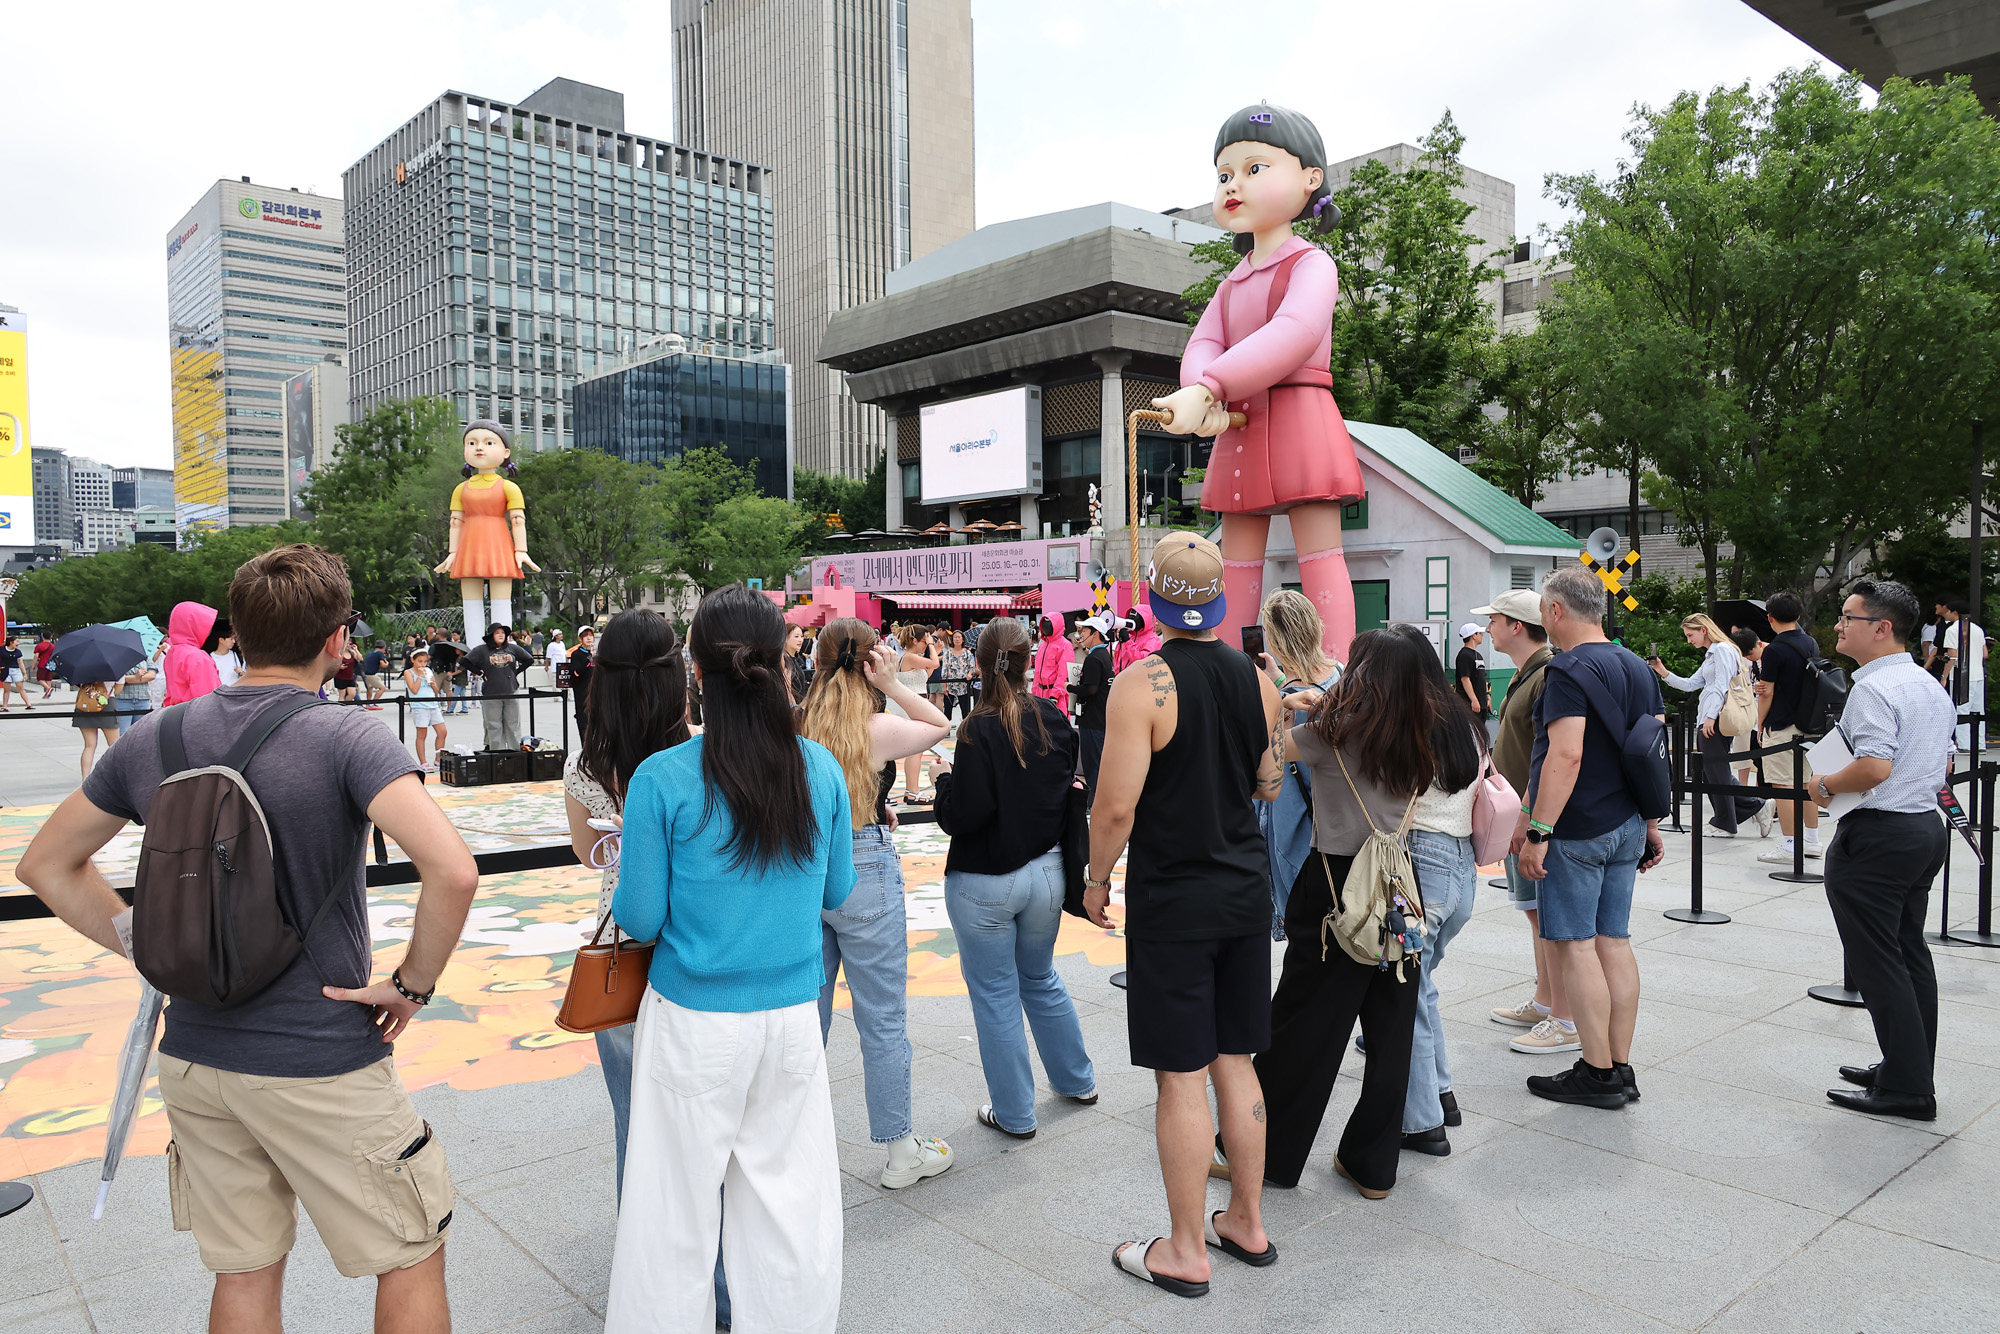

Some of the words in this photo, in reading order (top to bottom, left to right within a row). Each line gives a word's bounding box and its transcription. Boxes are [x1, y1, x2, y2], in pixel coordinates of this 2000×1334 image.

[261, 200, 322, 221] 감리회본부
[263, 214, 298, 226] Methodist
[299, 220, 323, 230] Center
[949, 438, 992, 453] 서울아리수본부
[981, 549, 1009, 557] 세종문화회관
[1009, 548, 1024, 556] 미술관
[862, 556, 903, 588] 모네에서
[906, 551, 972, 586] 앤디워홀까지
[1162, 573, 1219, 600] ドジャース
